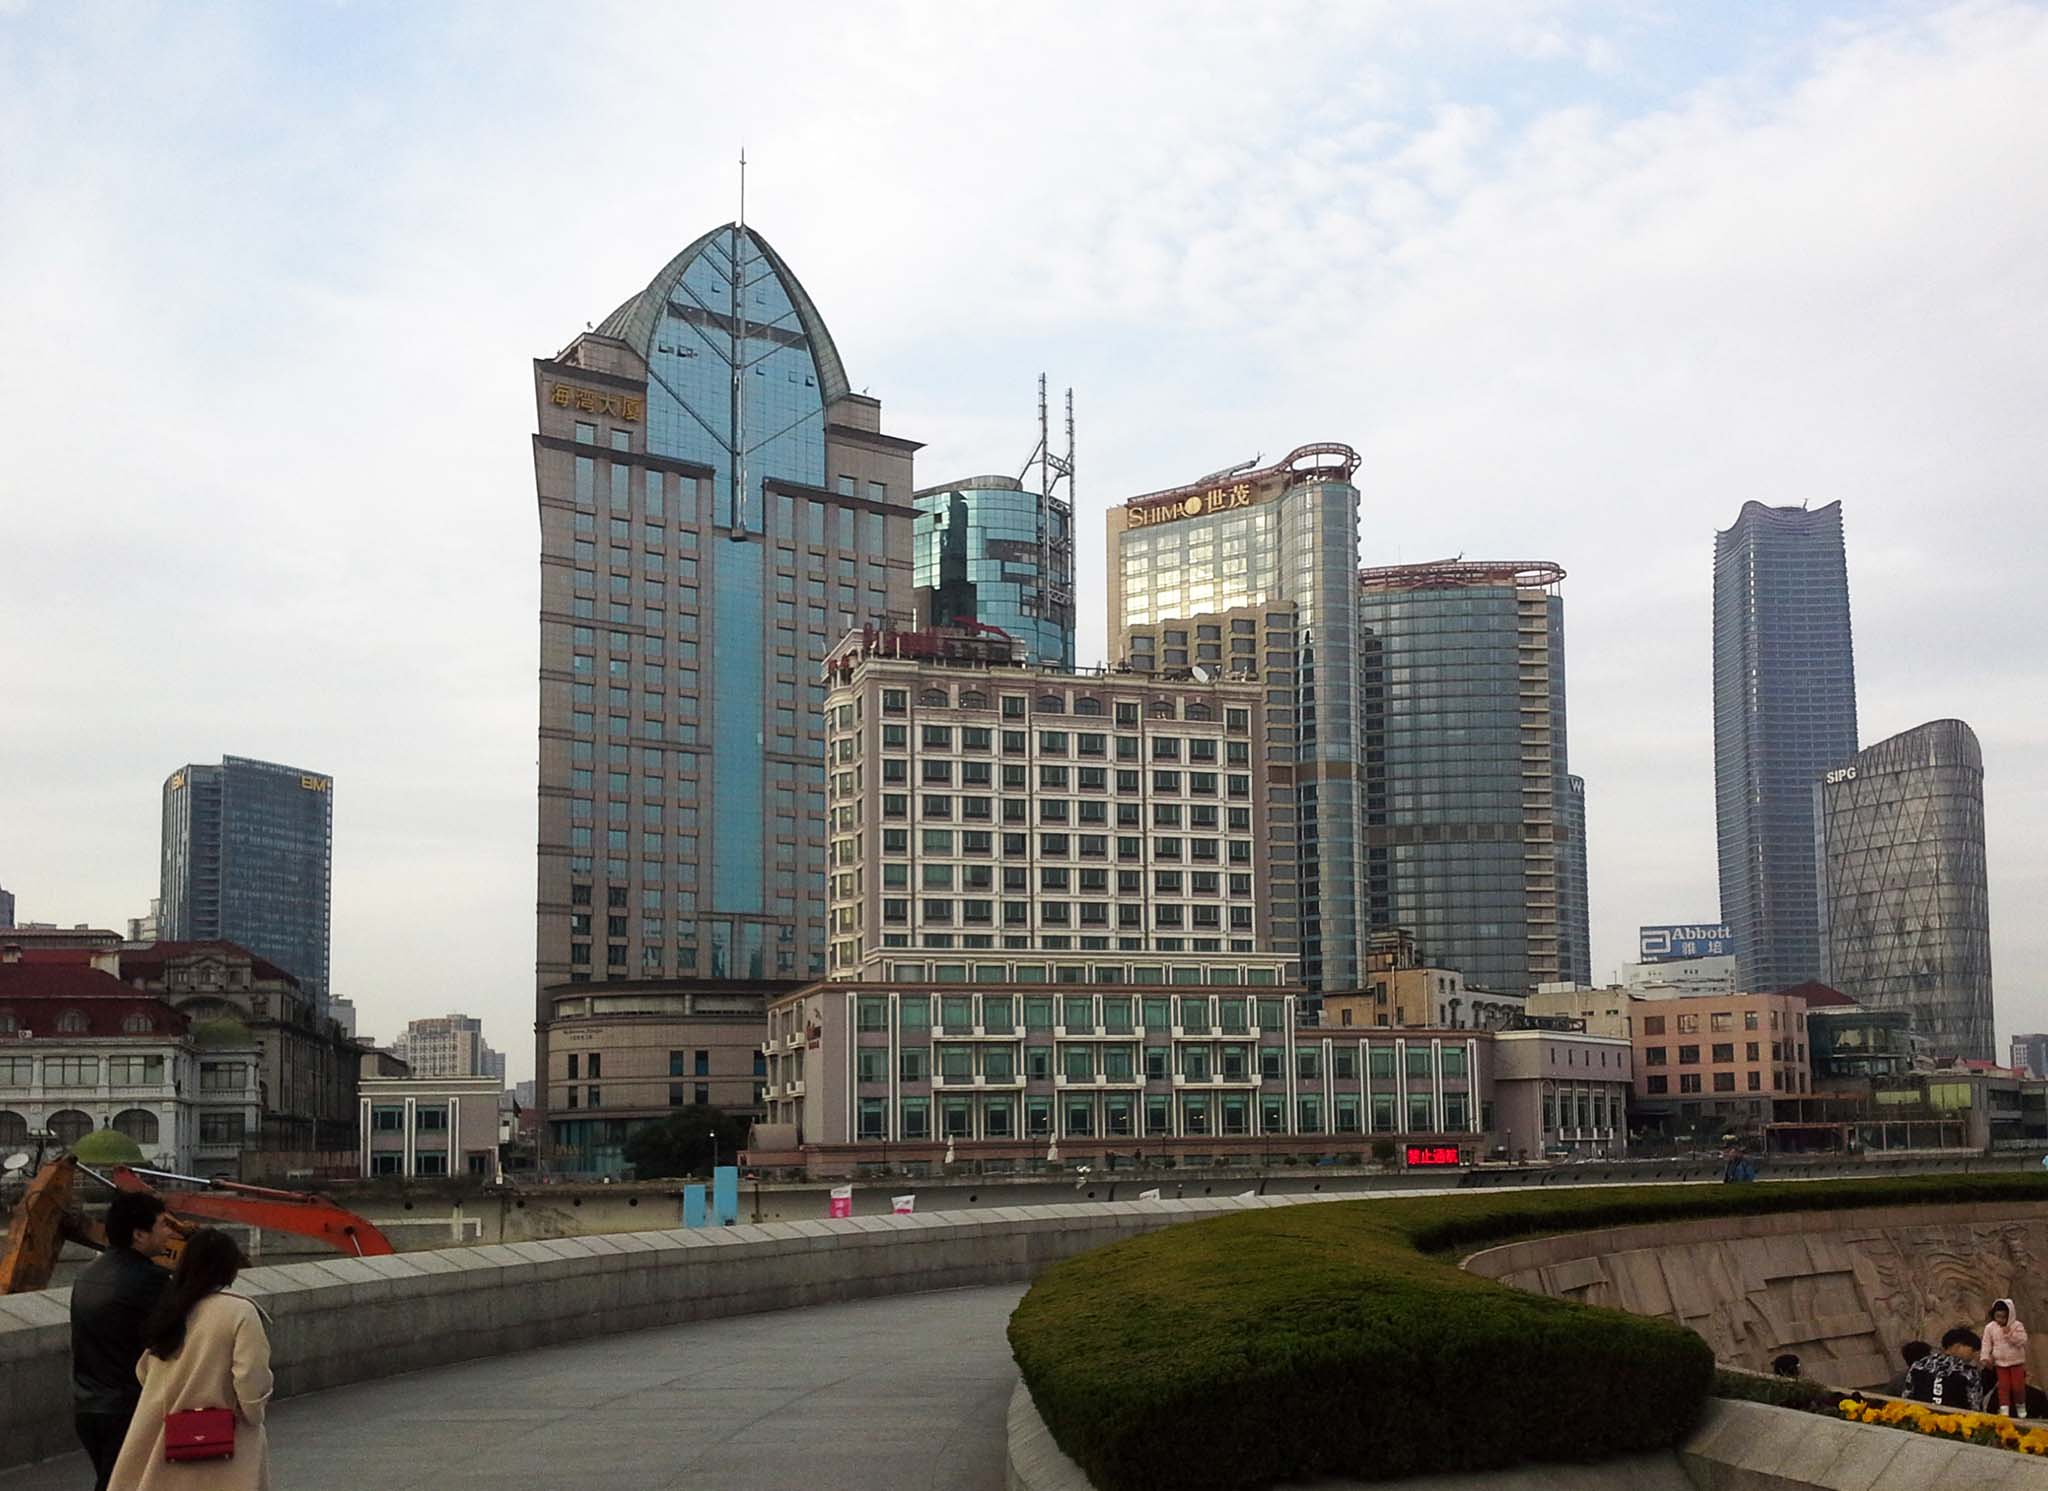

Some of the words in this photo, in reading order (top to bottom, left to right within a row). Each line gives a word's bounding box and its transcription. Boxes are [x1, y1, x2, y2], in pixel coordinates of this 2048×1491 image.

[1204, 484, 1250, 513] 世茂
[1827, 767, 1857, 784] SIPG
[1672, 926, 1732, 940] Abbott
